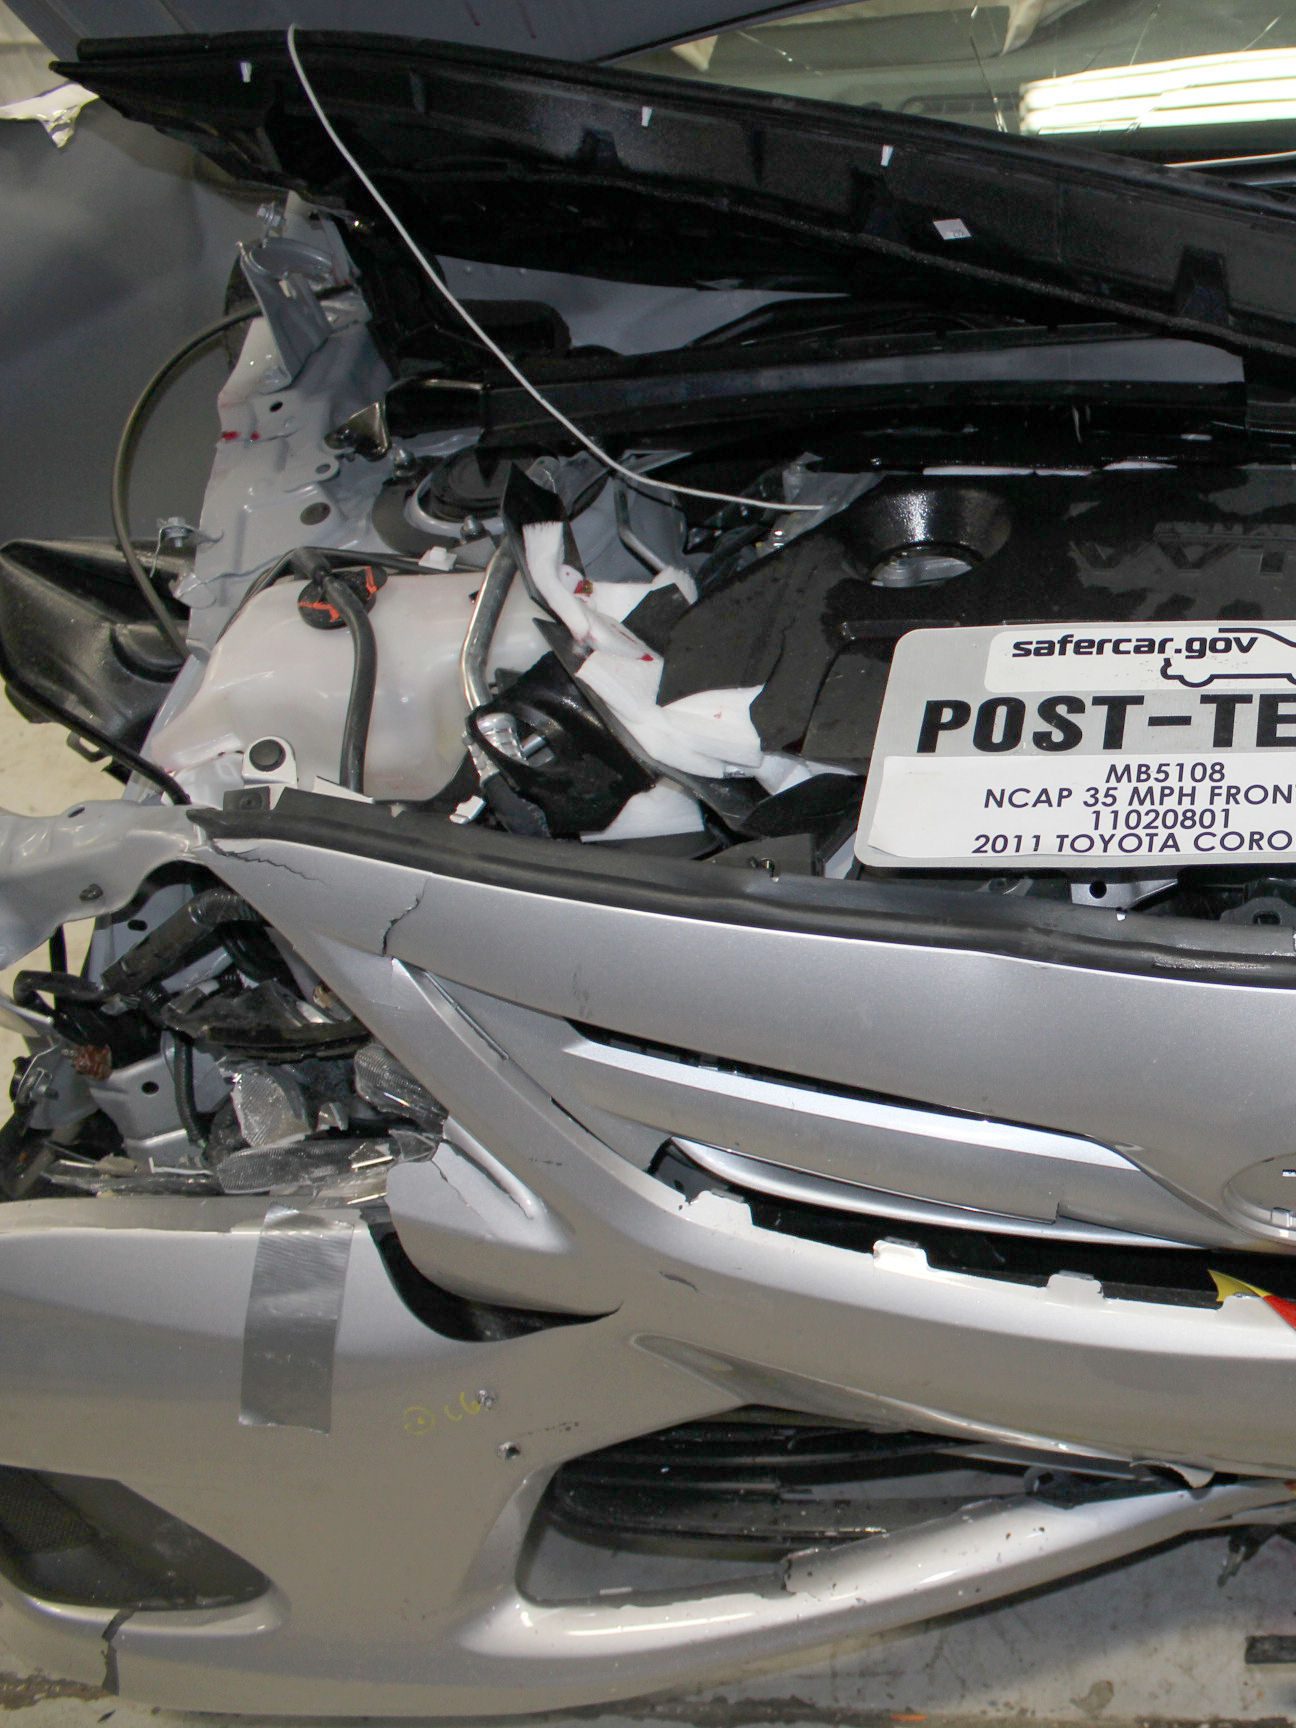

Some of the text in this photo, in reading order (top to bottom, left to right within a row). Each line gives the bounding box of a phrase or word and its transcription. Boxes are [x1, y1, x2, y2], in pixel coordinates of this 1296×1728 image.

[1010, 632, 1260, 661] safercar.gov
[1105, 762, 1225, 784] MB5108
[984, 787, 1073, 809] NCAP
[1083, 786, 1118, 808] 35
[1128, 785, 1196, 807] MPH
[1092, 808, 1230, 831] 11020801
[972, 834, 1041, 854] 2011
[1056, 832, 1181, 854] TOYOTA
